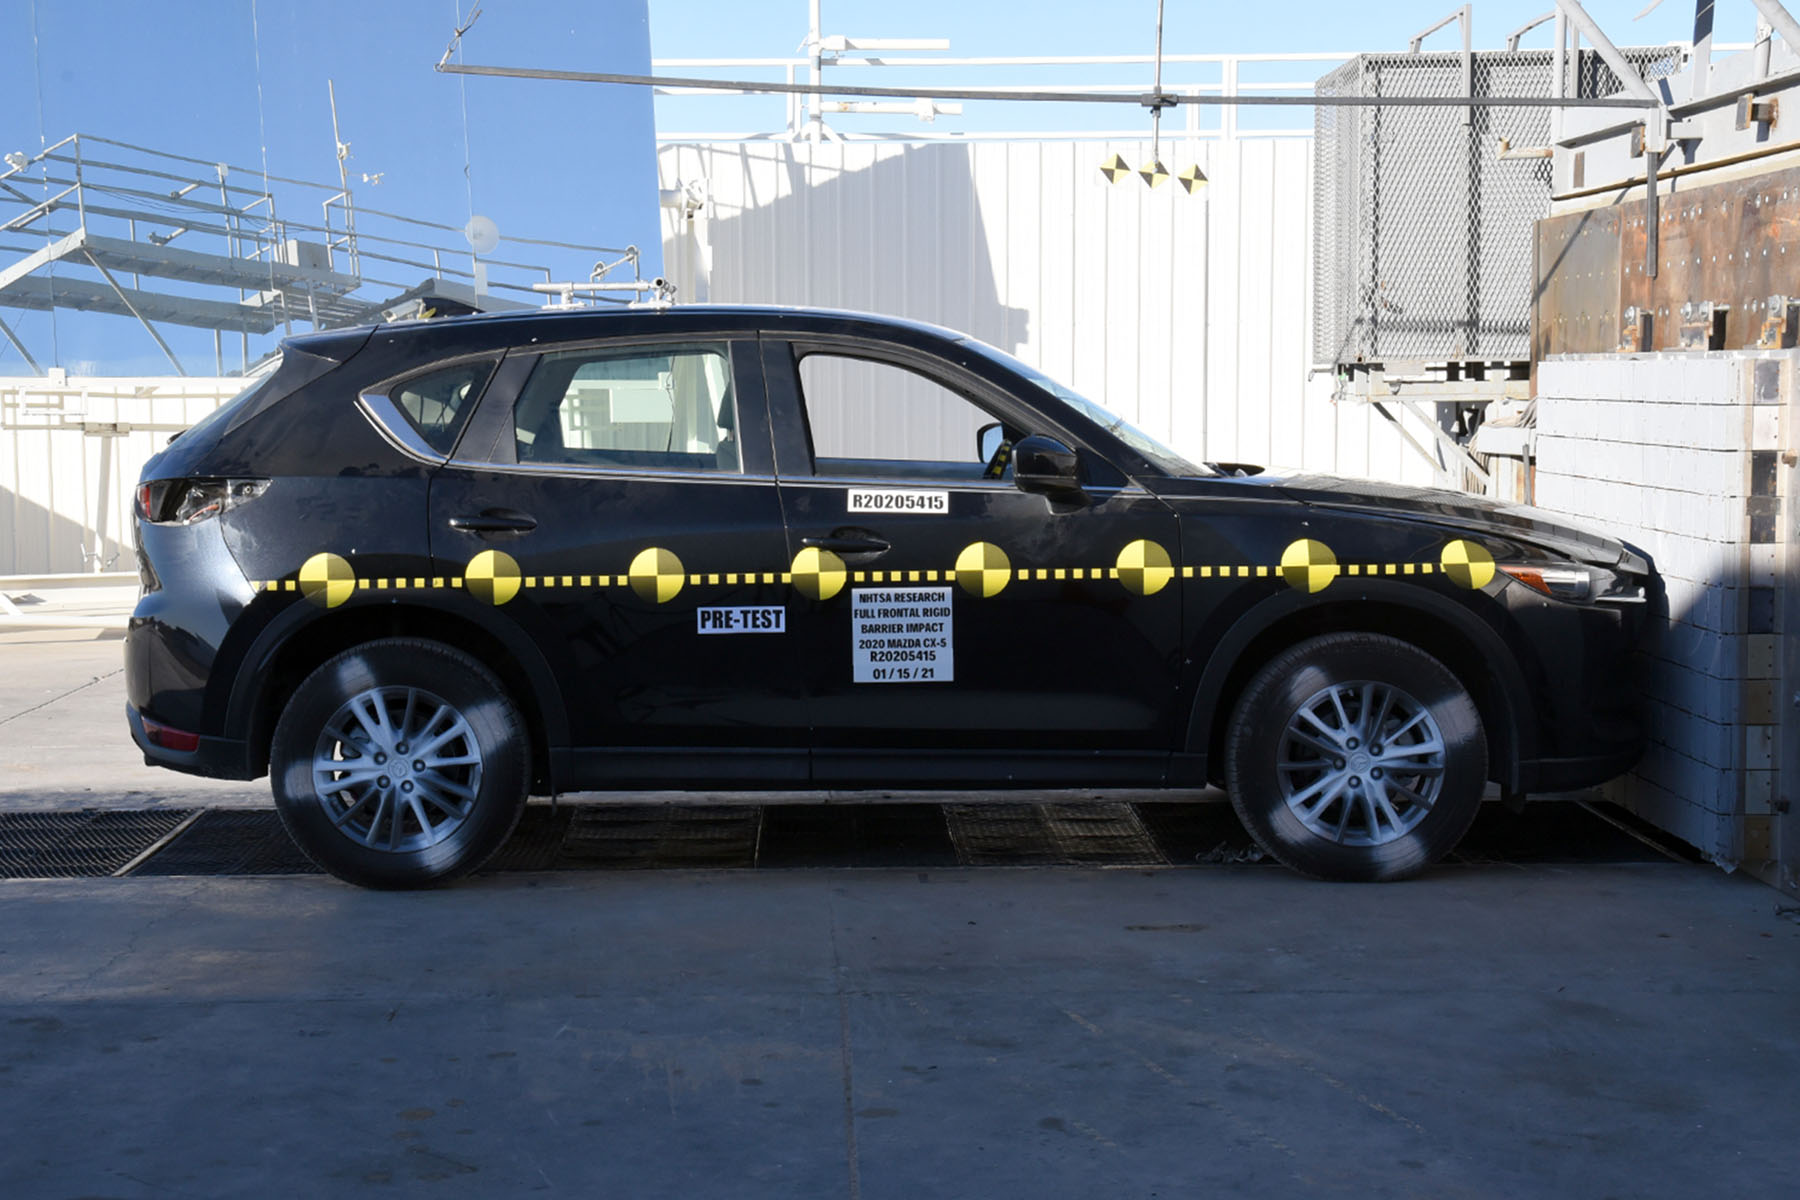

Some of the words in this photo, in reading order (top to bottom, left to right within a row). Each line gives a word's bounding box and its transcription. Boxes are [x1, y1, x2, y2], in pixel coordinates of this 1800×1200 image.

[853, 494, 944, 510] R20205415
[859, 593, 892, 603] NHTSA
[894, 592, 945, 602] RESEARCH
[700, 609, 783, 629] PRE-TEST
[854, 608, 876, 619] FULL
[878, 608, 920, 618] FRONTAL
[922, 607, 951, 617] RIGID
[861, 624, 904, 634] BARRIER
[906, 623, 944, 633] IMPACT
[859, 639, 885, 649] 2020
[887, 638, 921, 648] MAZDA
[923, 638, 947, 648] CX-5
[870, 650, 937, 662] R20205415
